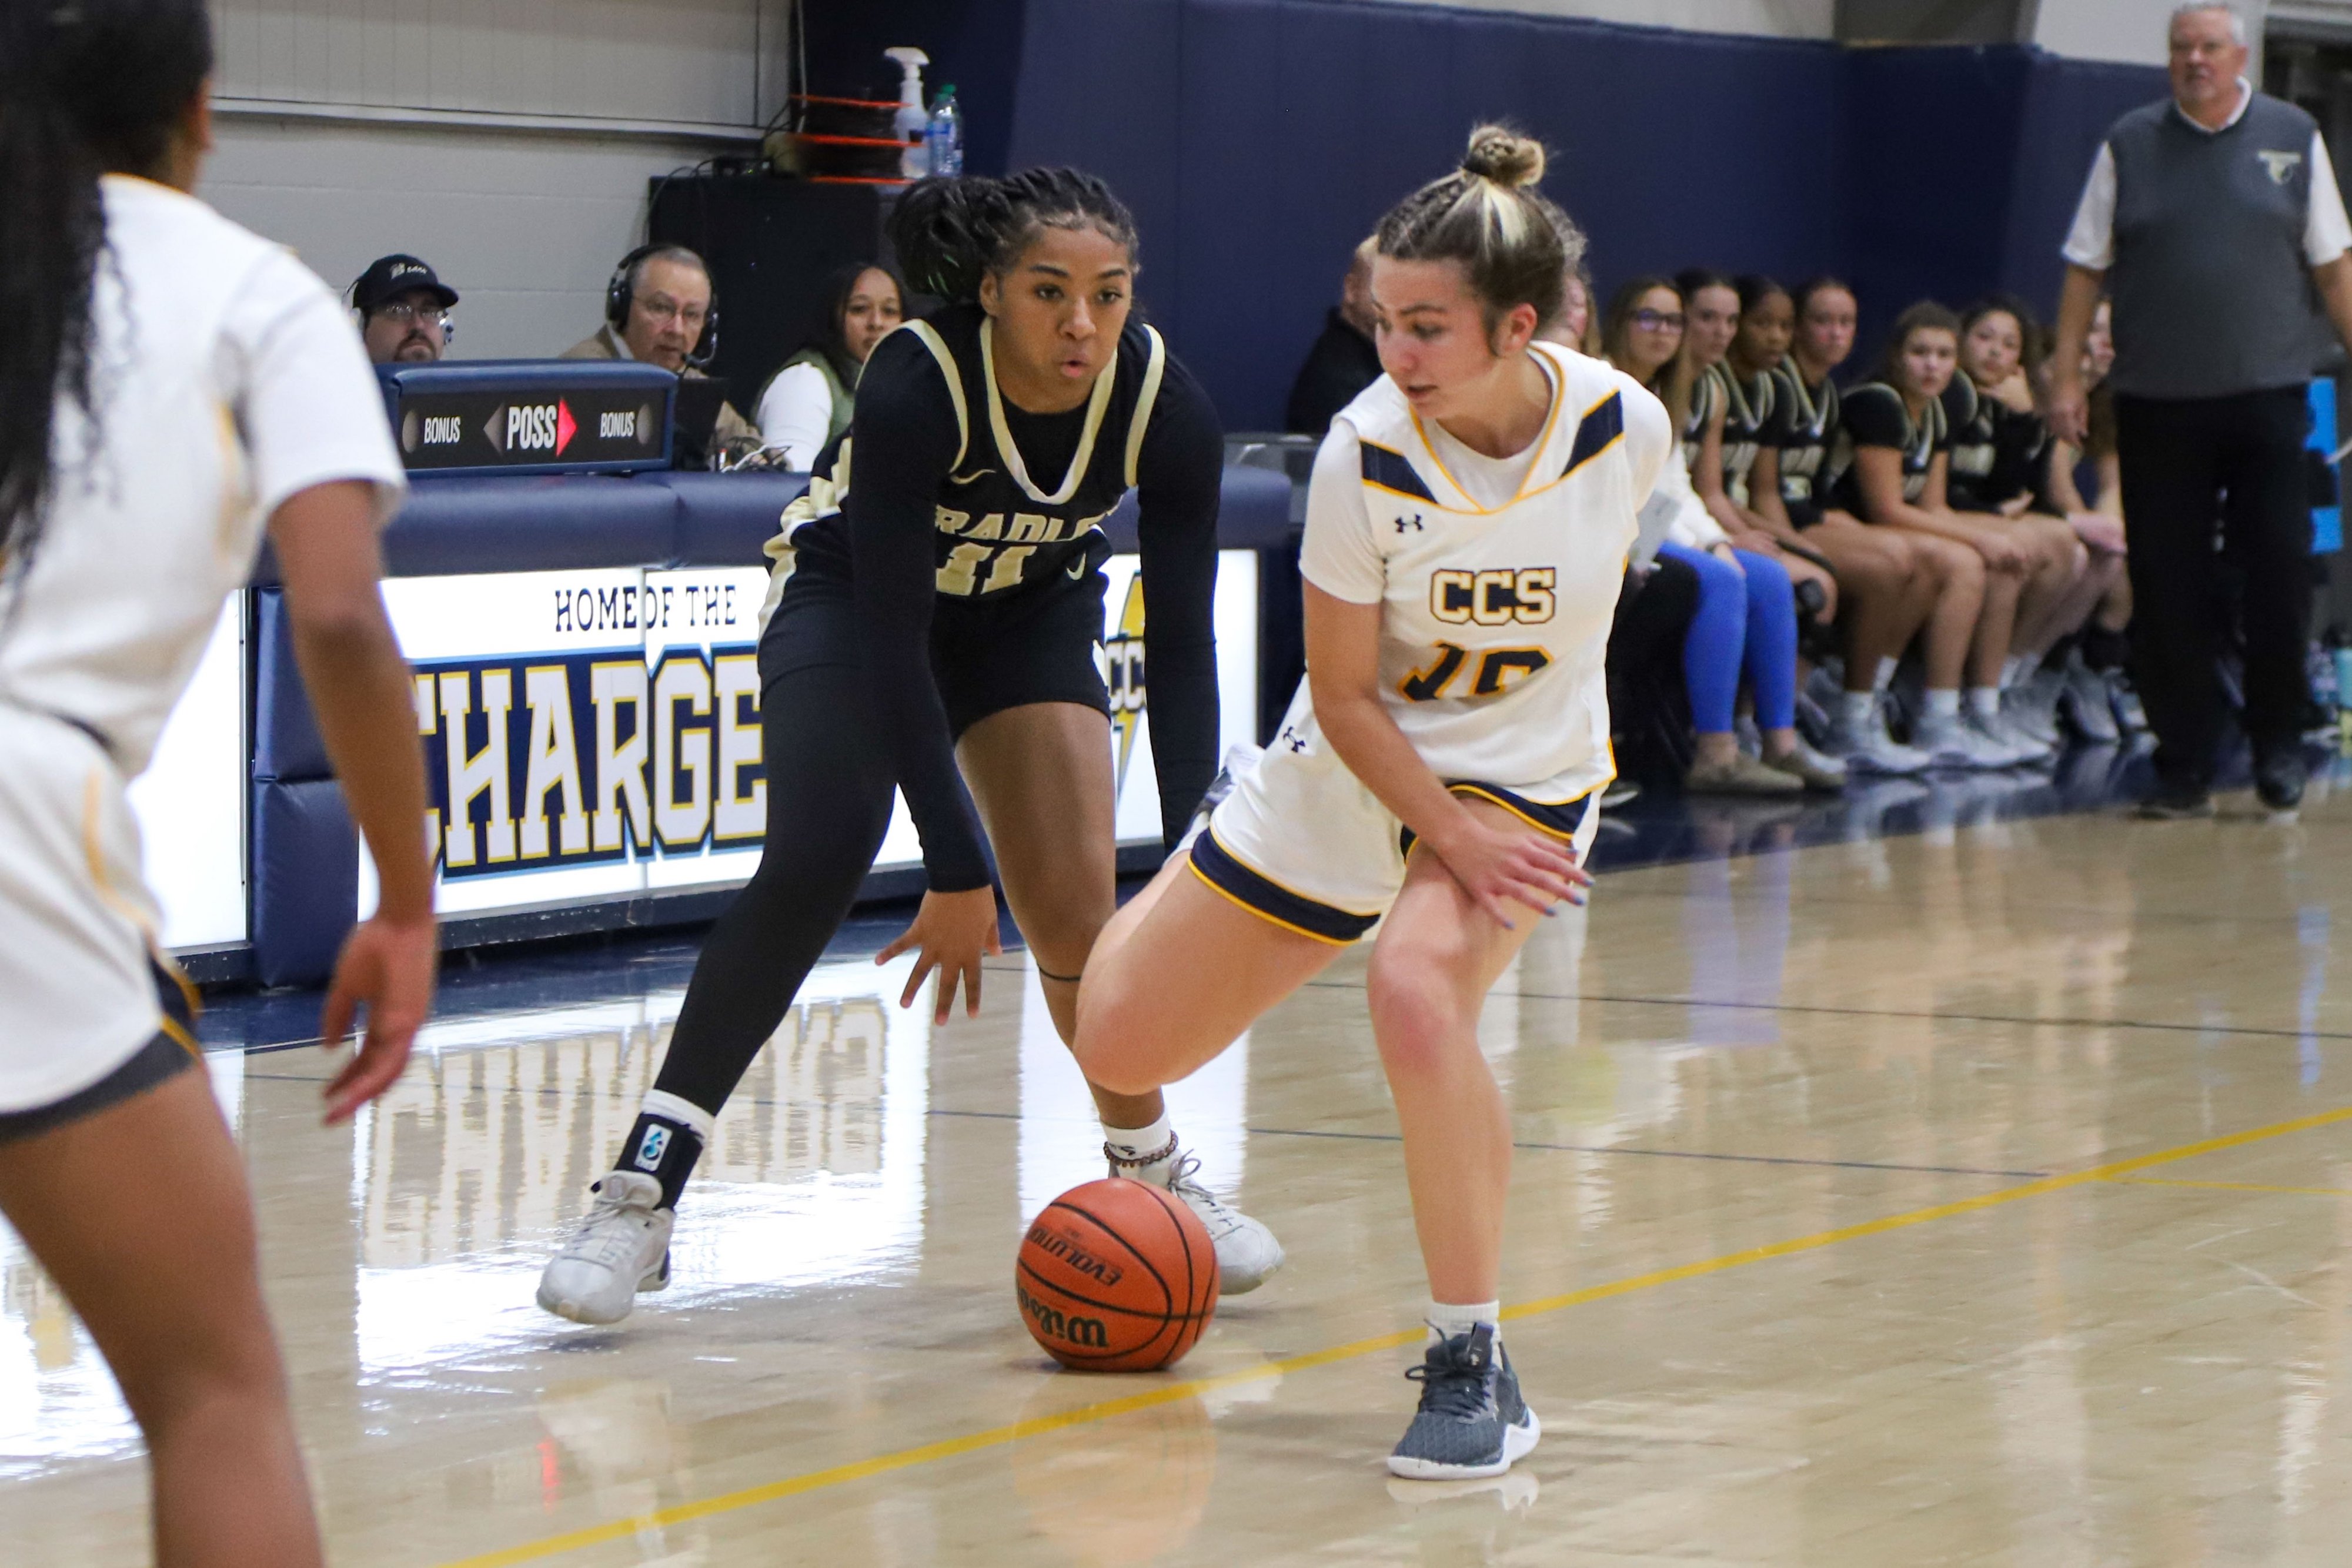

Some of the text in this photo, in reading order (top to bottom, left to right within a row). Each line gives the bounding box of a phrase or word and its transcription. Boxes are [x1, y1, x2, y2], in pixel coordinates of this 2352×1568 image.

[423, 416, 461, 444] BONUS
[506, 404, 557, 450] POSS
[600, 412, 636, 438] BONUS
[555, 585, 736, 632] HOME OF THE
[1430, 567, 1556, 626] CCS
